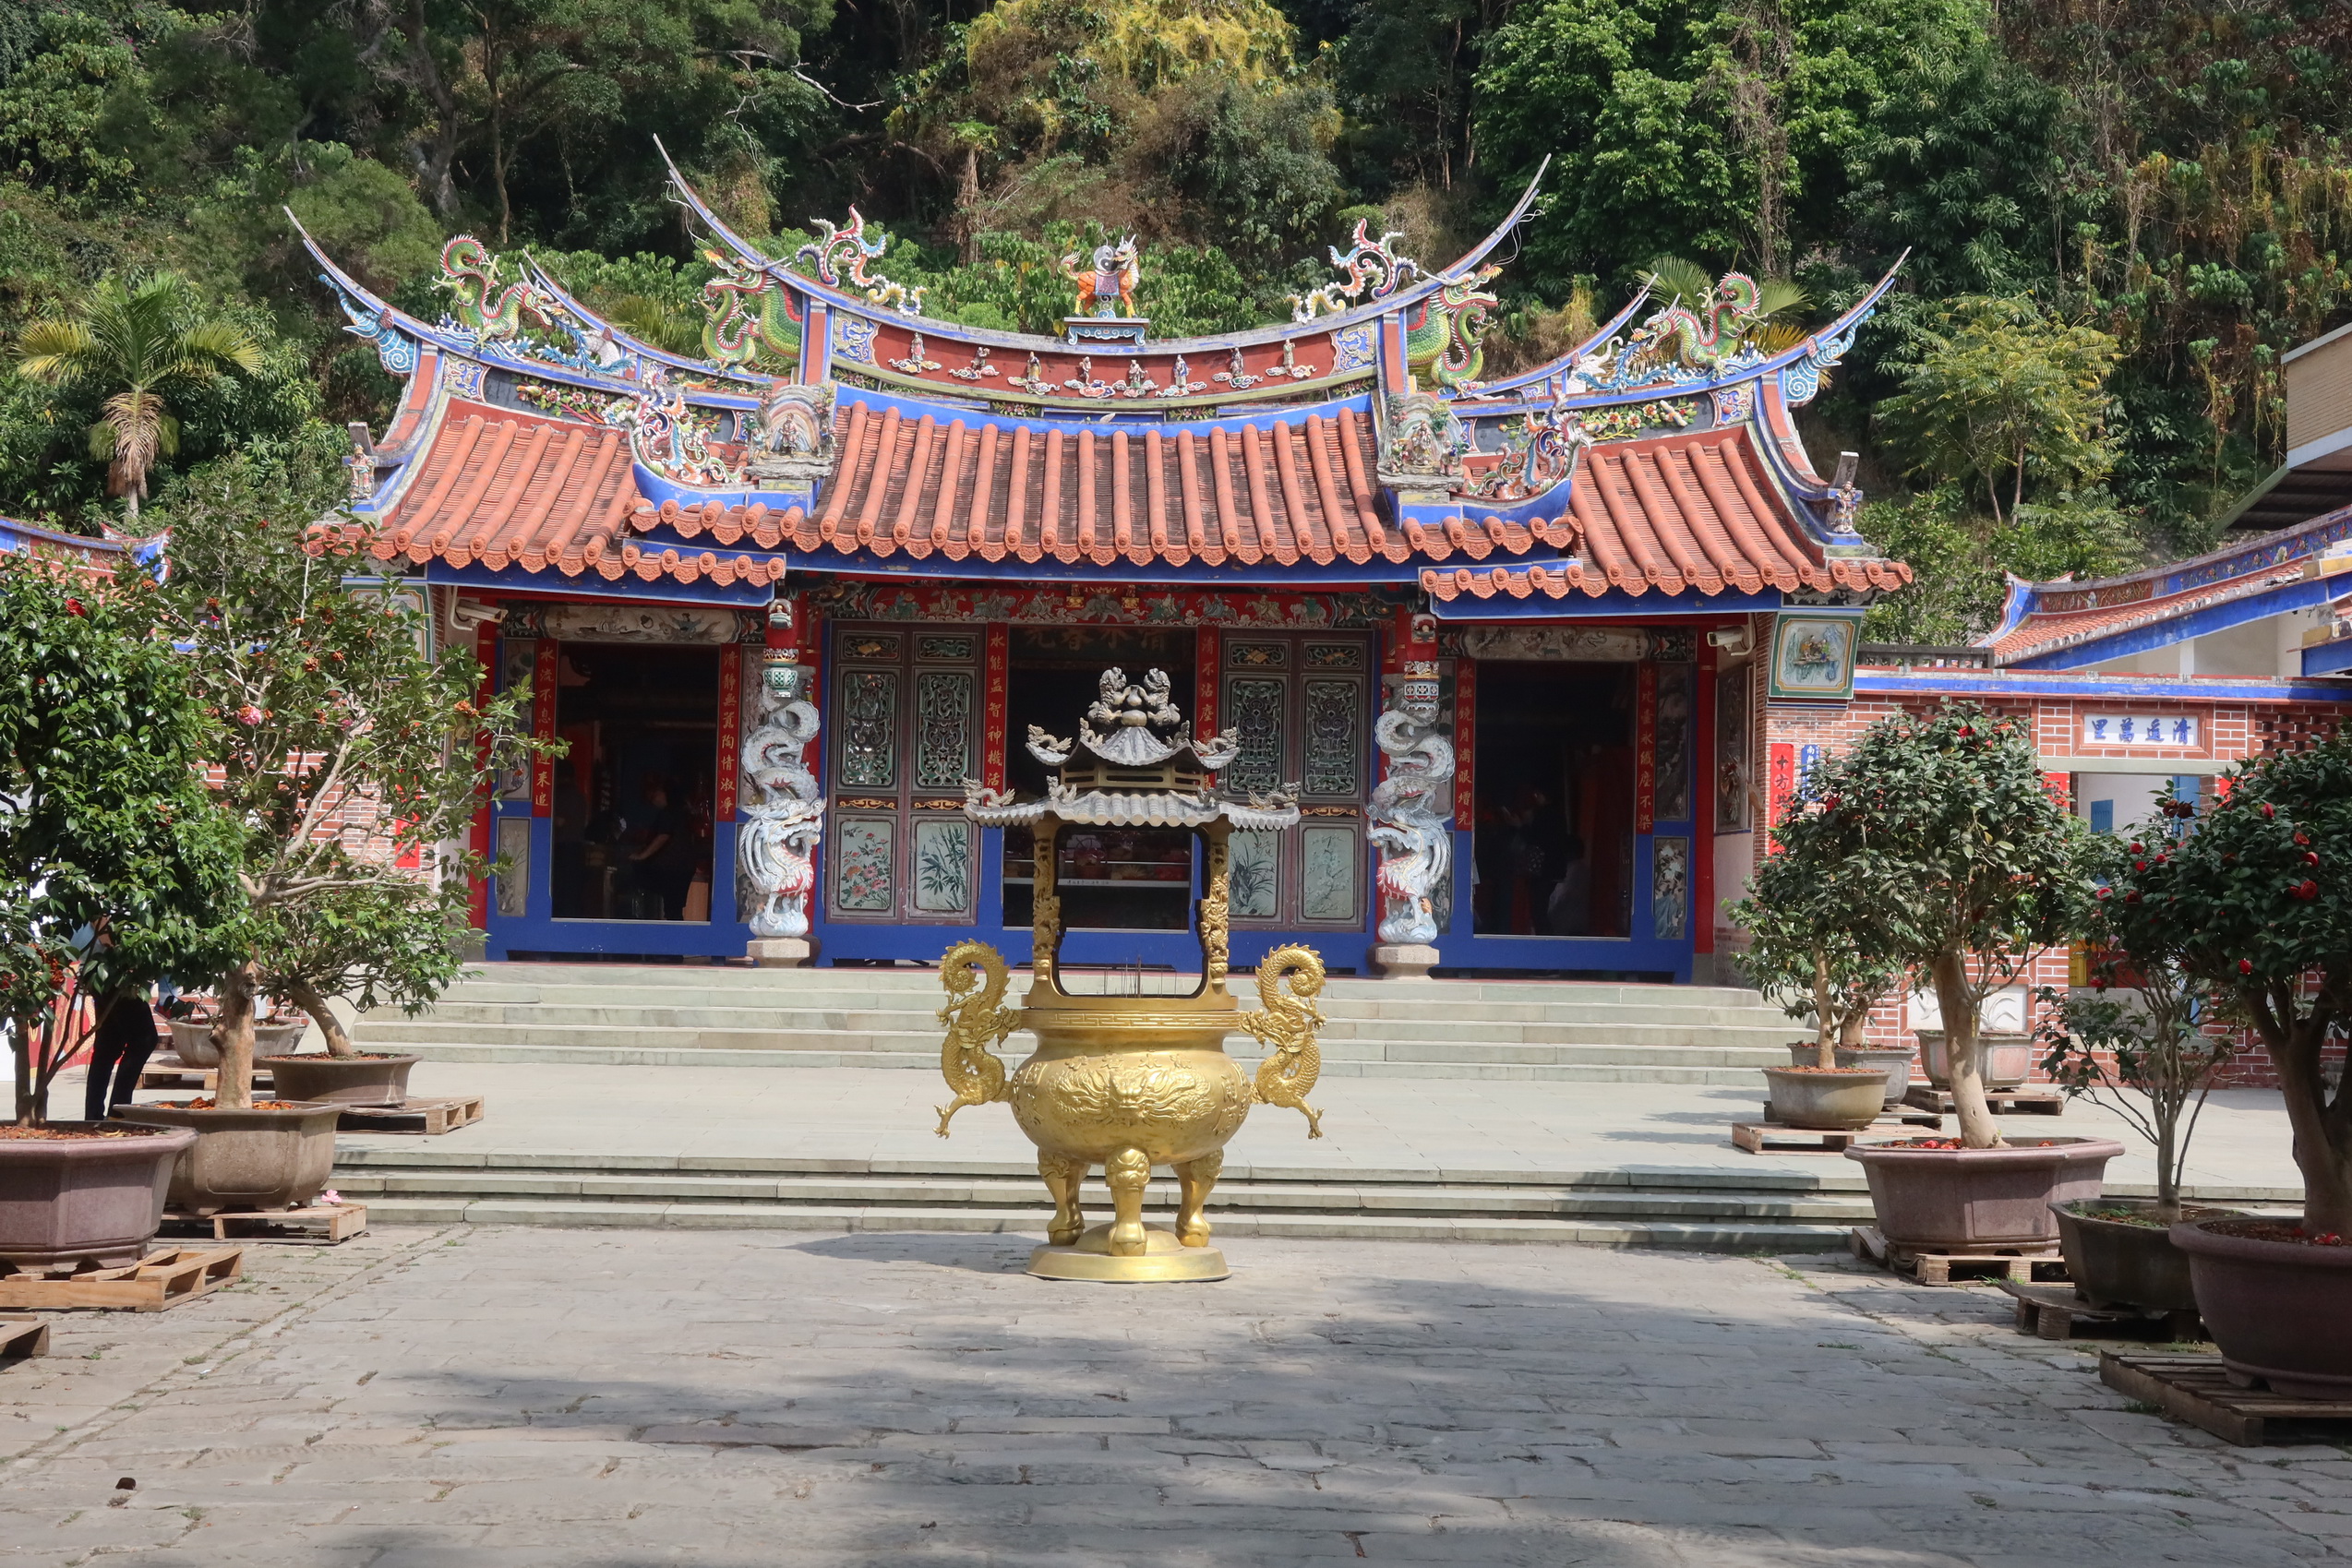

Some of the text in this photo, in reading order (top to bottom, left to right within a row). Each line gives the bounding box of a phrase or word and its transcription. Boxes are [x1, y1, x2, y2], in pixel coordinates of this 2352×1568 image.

[987, 631, 1004, 787] 水能益智神機活
